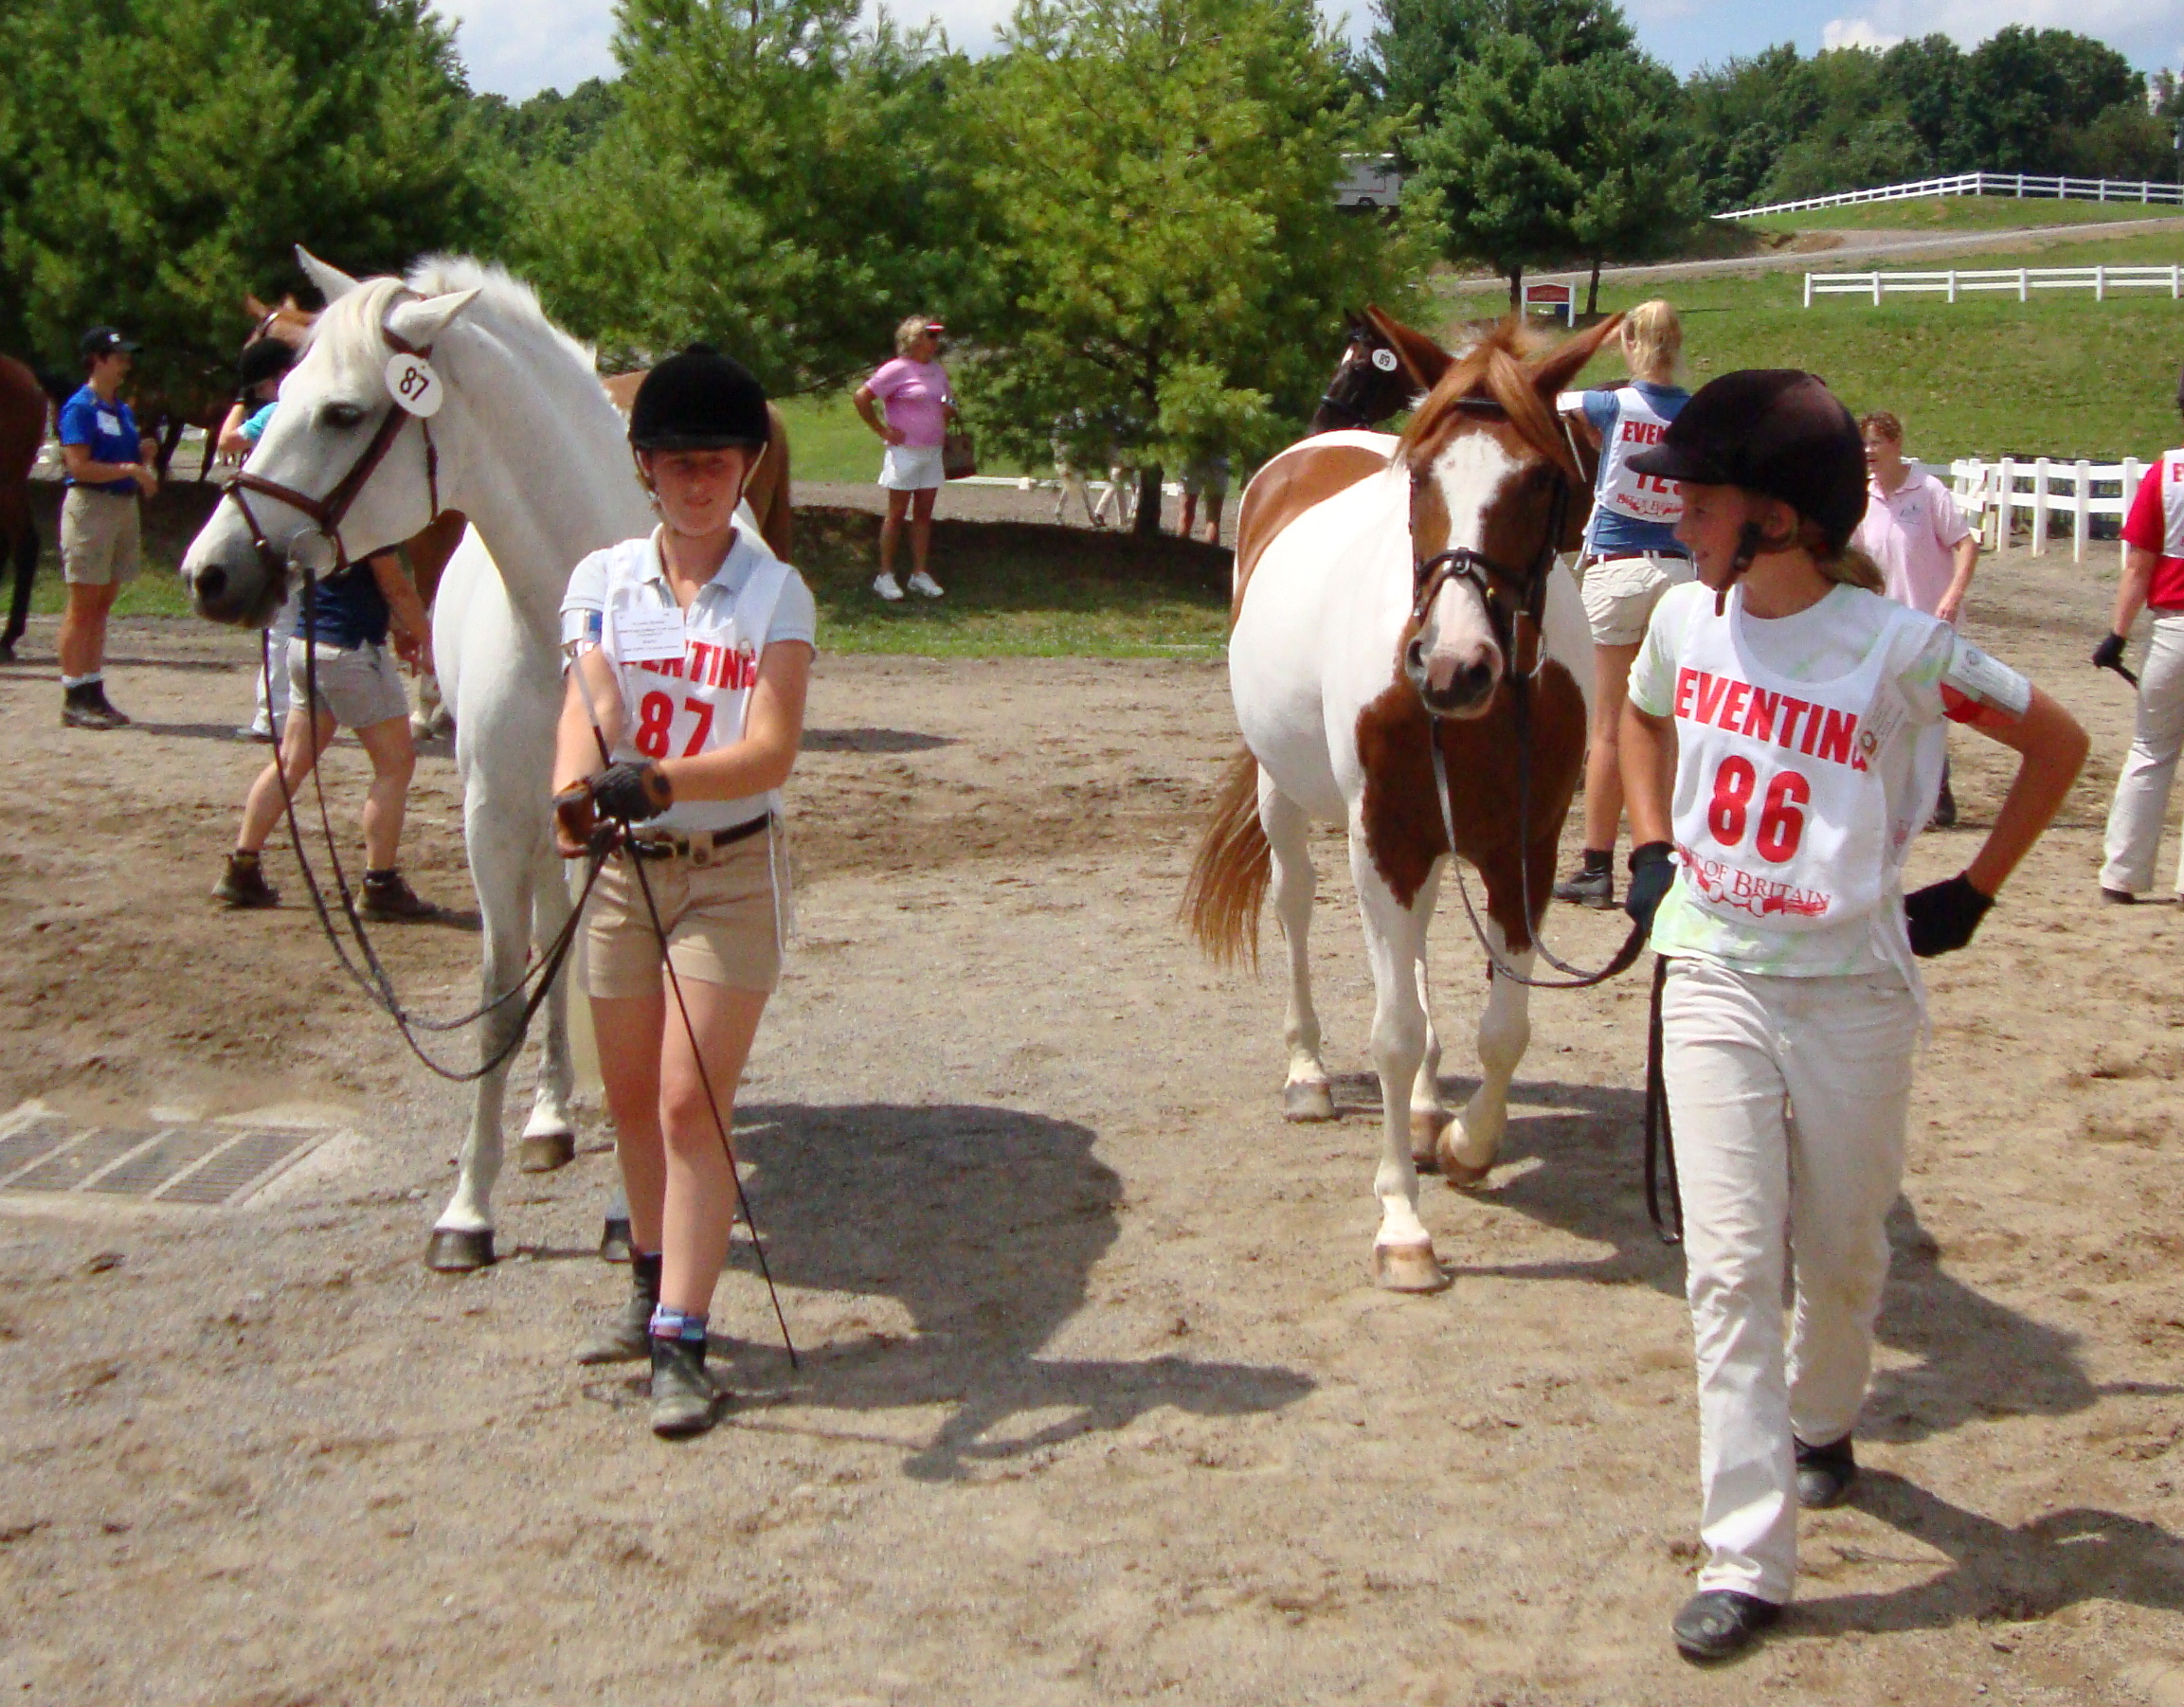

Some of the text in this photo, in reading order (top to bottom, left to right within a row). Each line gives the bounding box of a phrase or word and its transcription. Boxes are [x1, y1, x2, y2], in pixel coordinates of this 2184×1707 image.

[400, 367, 430, 402] 87
[635, 691, 714, 759] 87
[1707, 755, 1811, 863] 86
[1704, 860, 1831, 907] OF BRITAIN
